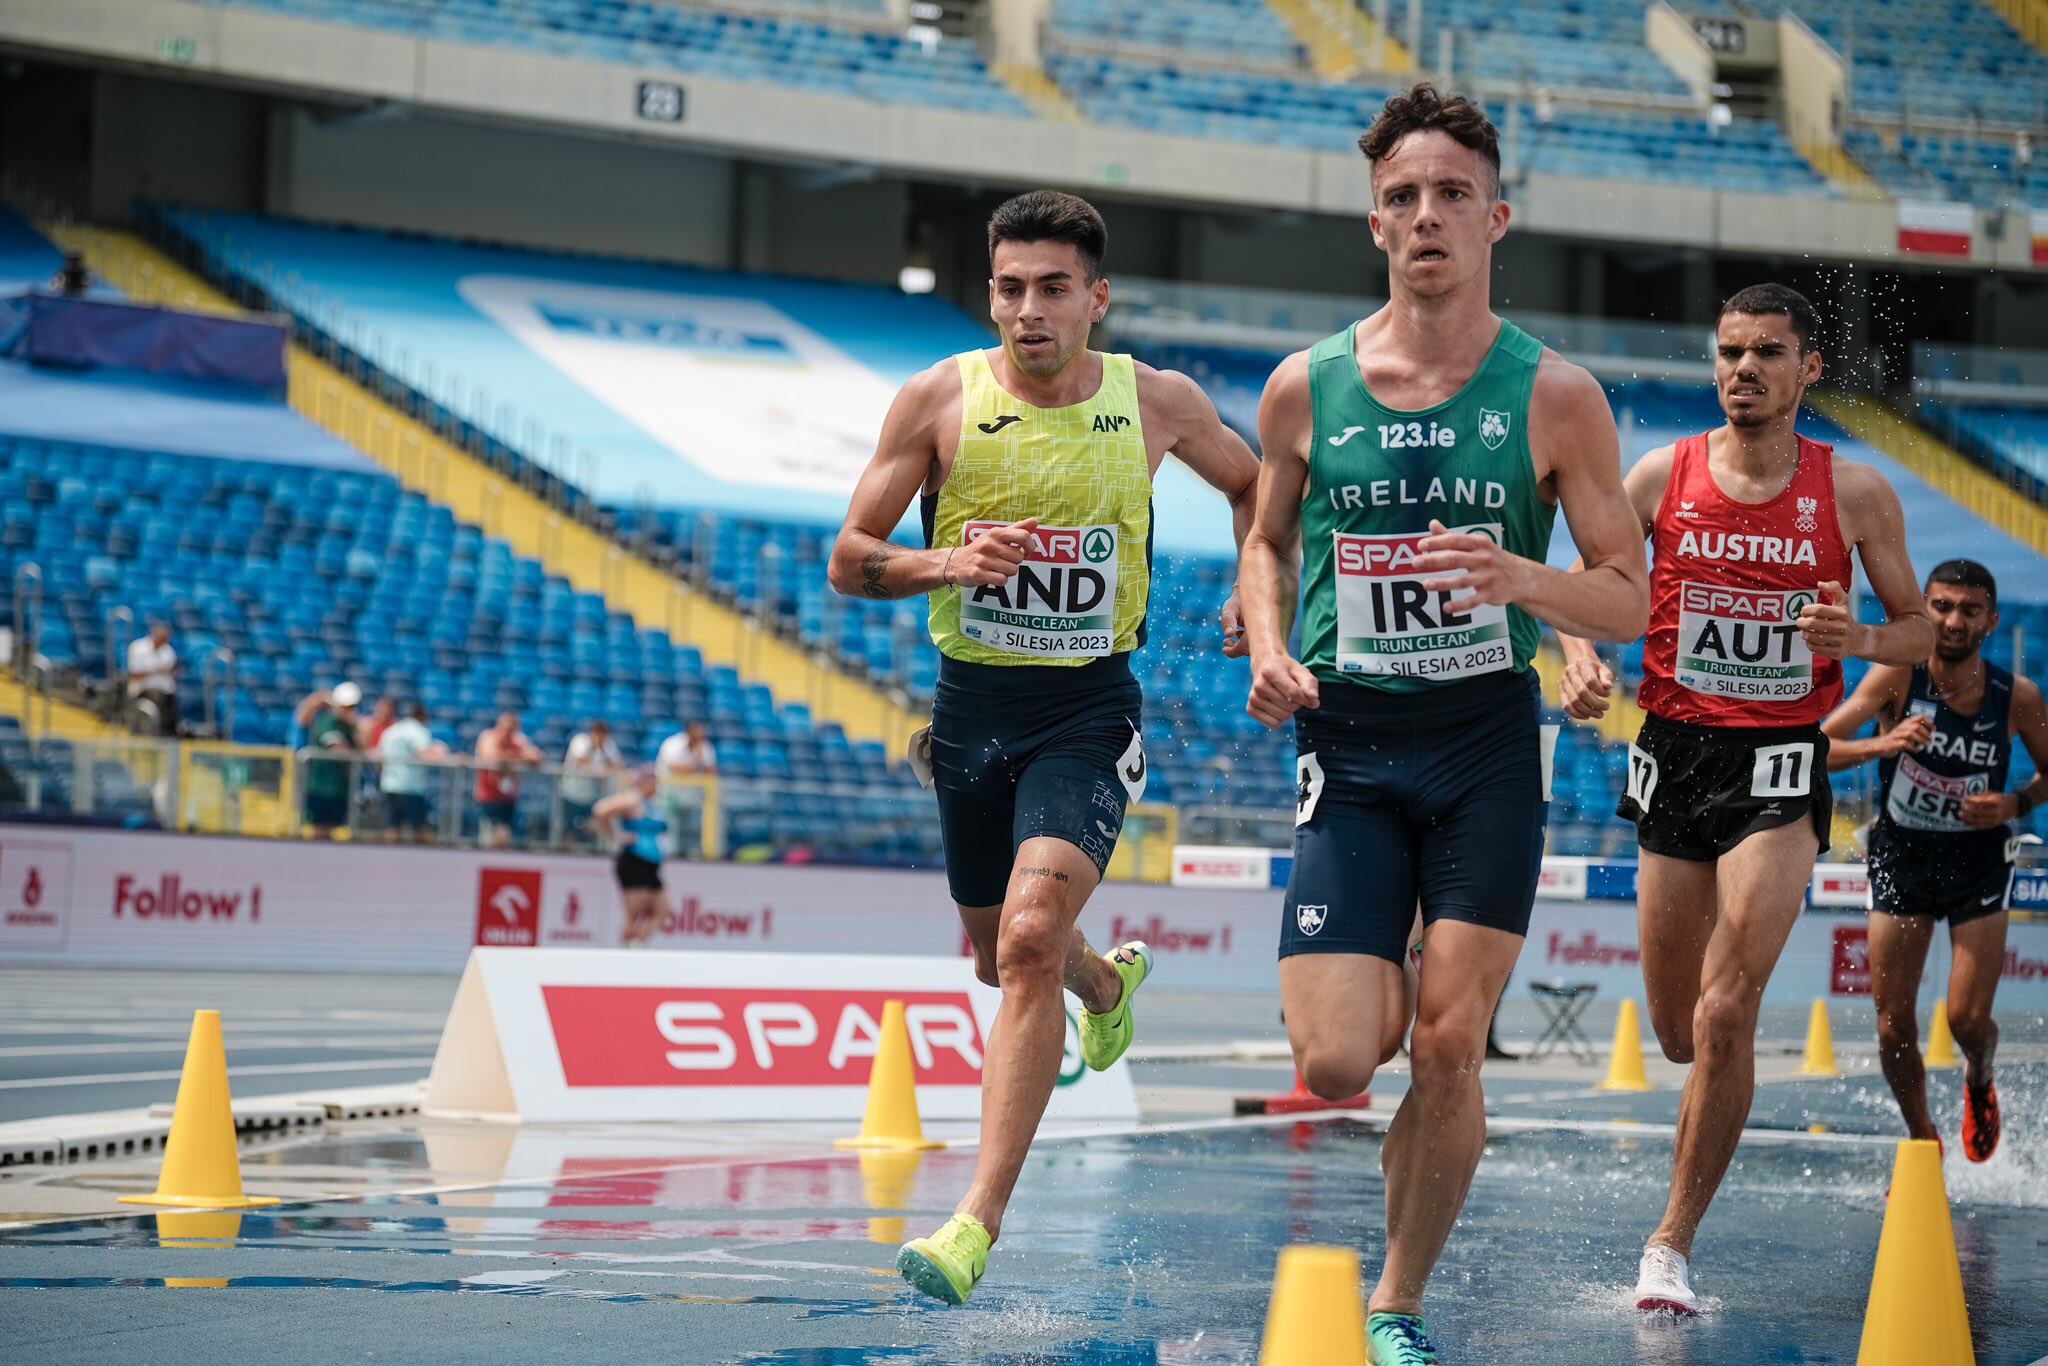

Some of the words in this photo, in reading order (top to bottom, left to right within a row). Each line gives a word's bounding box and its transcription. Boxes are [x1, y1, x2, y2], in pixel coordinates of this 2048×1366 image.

[1377, 421, 1456, 449] 123.ie
[1329, 476, 1506, 511] IRELAND
[1340, 542, 1420, 571] SPA
[1677, 530, 1817, 567] AUSTRIA
[1686, 589, 1781, 618] SPAR
[999, 613, 1029, 626] RUN
[1005, 632, 1065, 650] SILESIA
[1069, 636, 1109, 650] 2023
[1381, 638, 1413, 652] RUN
[1692, 618, 1801, 663] AUT
[1391, 656, 1460, 676] SILESIA
[1464, 646, 1507, 668] 2023
[1710, 663, 1739, 675] RUN
[1717, 680, 1771, 695] SILESIA
[1774, 682, 1808, 695] 2023
[1768, 751, 1803, 789] 11
[113, 872, 240, 920] Follow
[655, 1000, 985, 1071] SPAR
